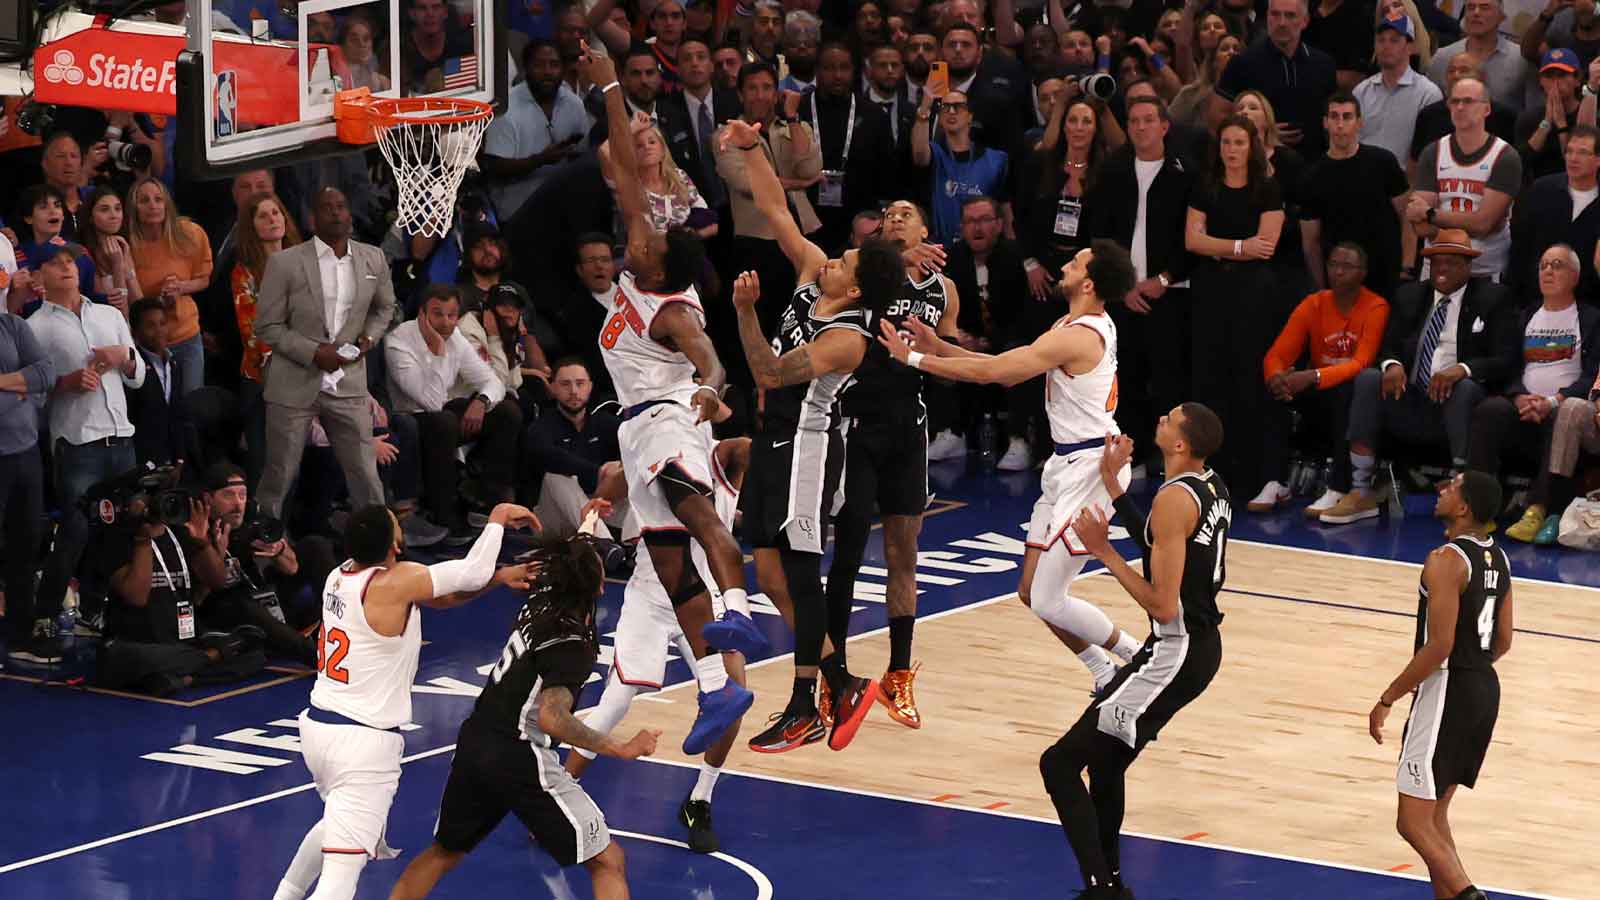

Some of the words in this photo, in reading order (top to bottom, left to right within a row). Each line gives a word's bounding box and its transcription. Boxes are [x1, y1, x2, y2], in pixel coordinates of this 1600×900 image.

[600, 311, 626, 351] 8
[1483, 569, 1500, 590] FOX
[1477, 595, 1497, 651] 4
[492, 629, 527, 685] 5
